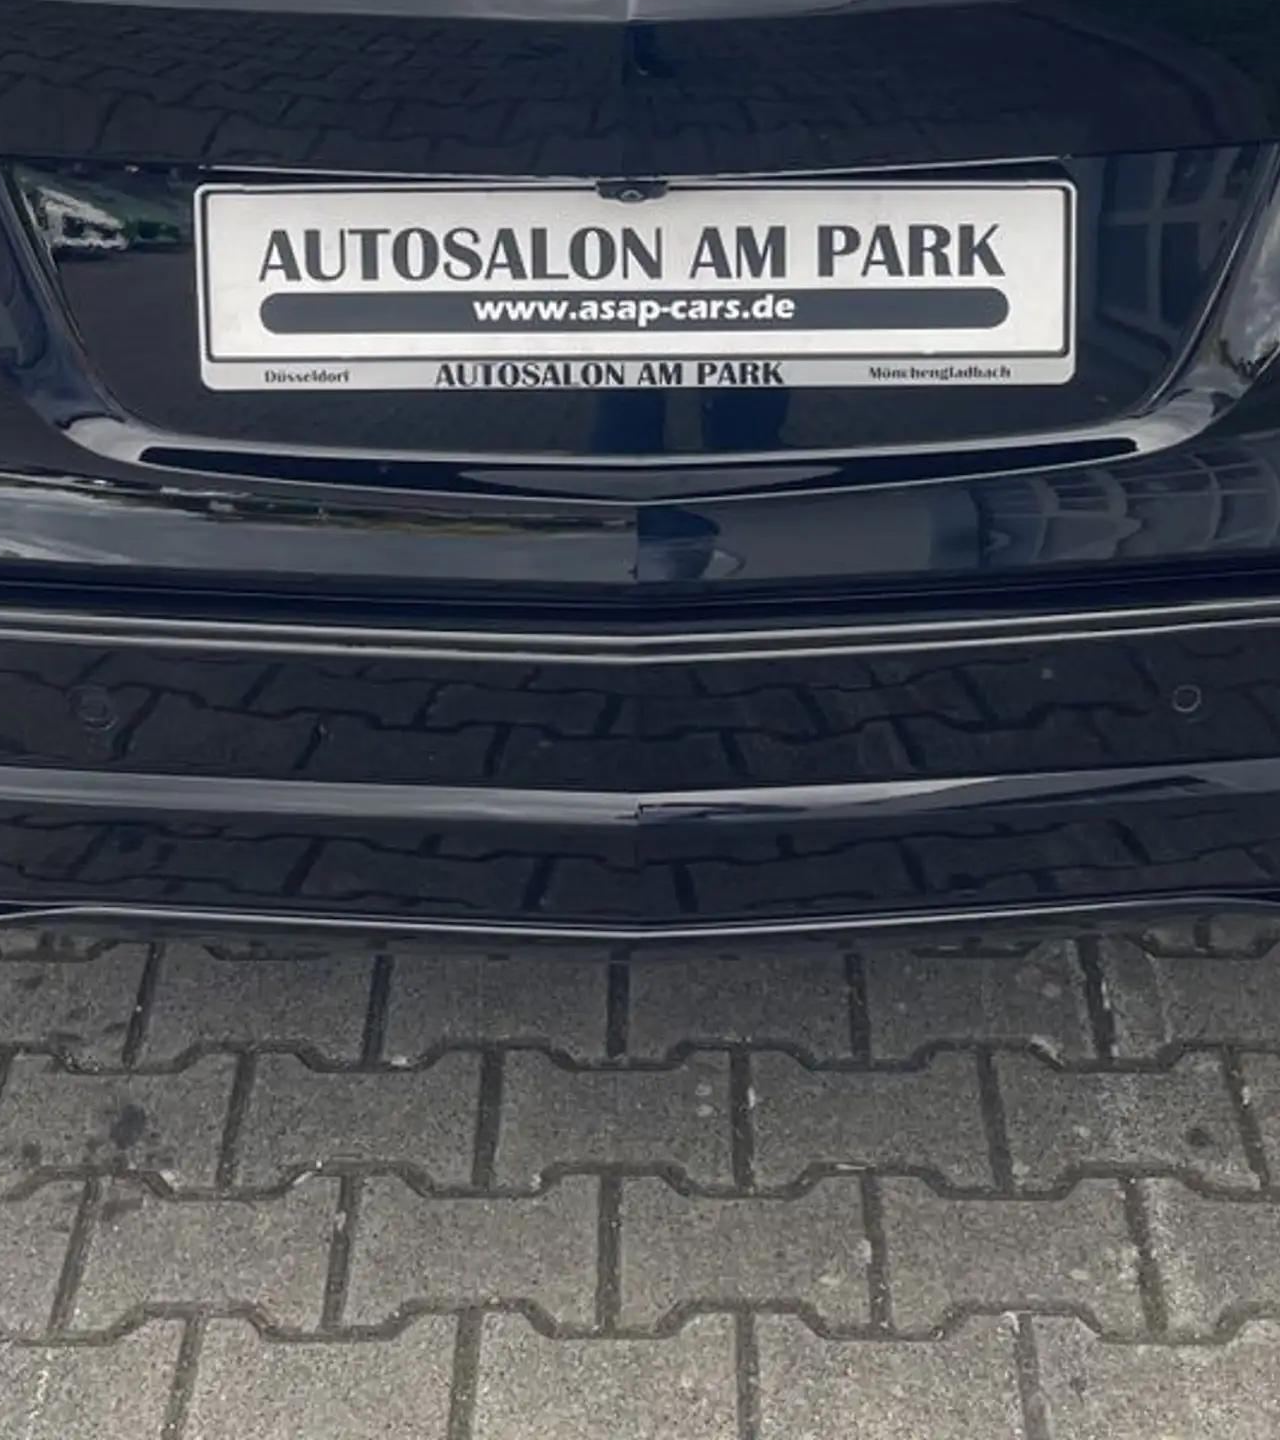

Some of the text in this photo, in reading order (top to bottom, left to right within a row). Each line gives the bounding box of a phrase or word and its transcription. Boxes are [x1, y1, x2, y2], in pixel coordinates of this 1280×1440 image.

[259, 223, 1006, 282] AUTOSALON AM PARK
[472, 294, 796, 328] www.asap-cars.de
[264, 368, 350, 383] Düsseldorf
[434, 360, 785, 388] AUTOSALON AM PARK
[869, 365, 1012, 380] Mönchengladbach
